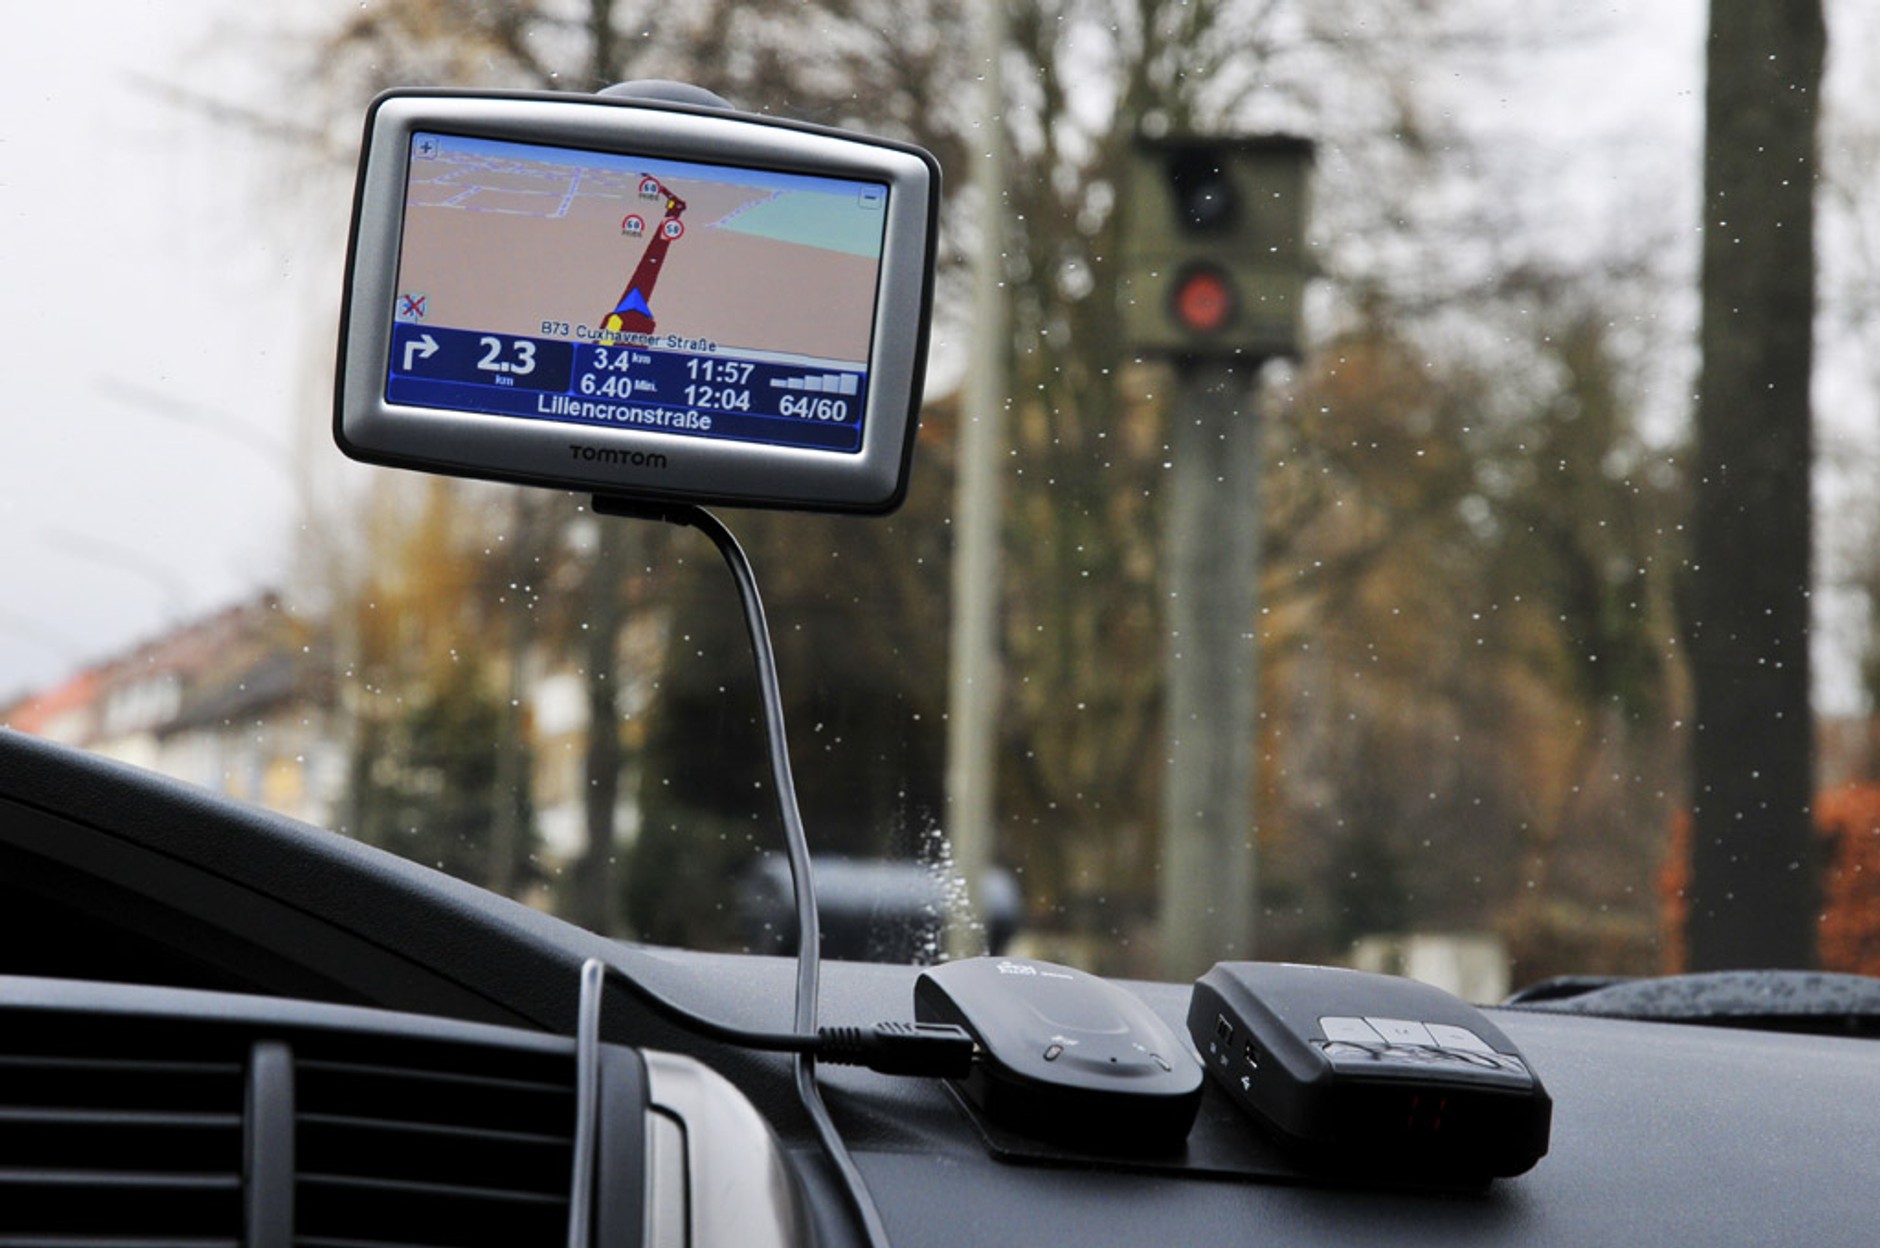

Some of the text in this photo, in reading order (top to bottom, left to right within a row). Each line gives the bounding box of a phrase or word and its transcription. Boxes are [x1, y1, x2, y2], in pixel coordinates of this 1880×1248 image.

[541, 321, 717, 352] B73 Cuxhavener Straße
[477, 336, 536, 375] 2.3
[593, 348, 651, 372] 3.4 km
[495, 374, 514, 386] km
[687, 358, 755, 385] 11:57
[580, 373, 632, 399] 6.40
[684, 385, 750, 411] 12:04
[779, 395, 847, 421] 64/60
